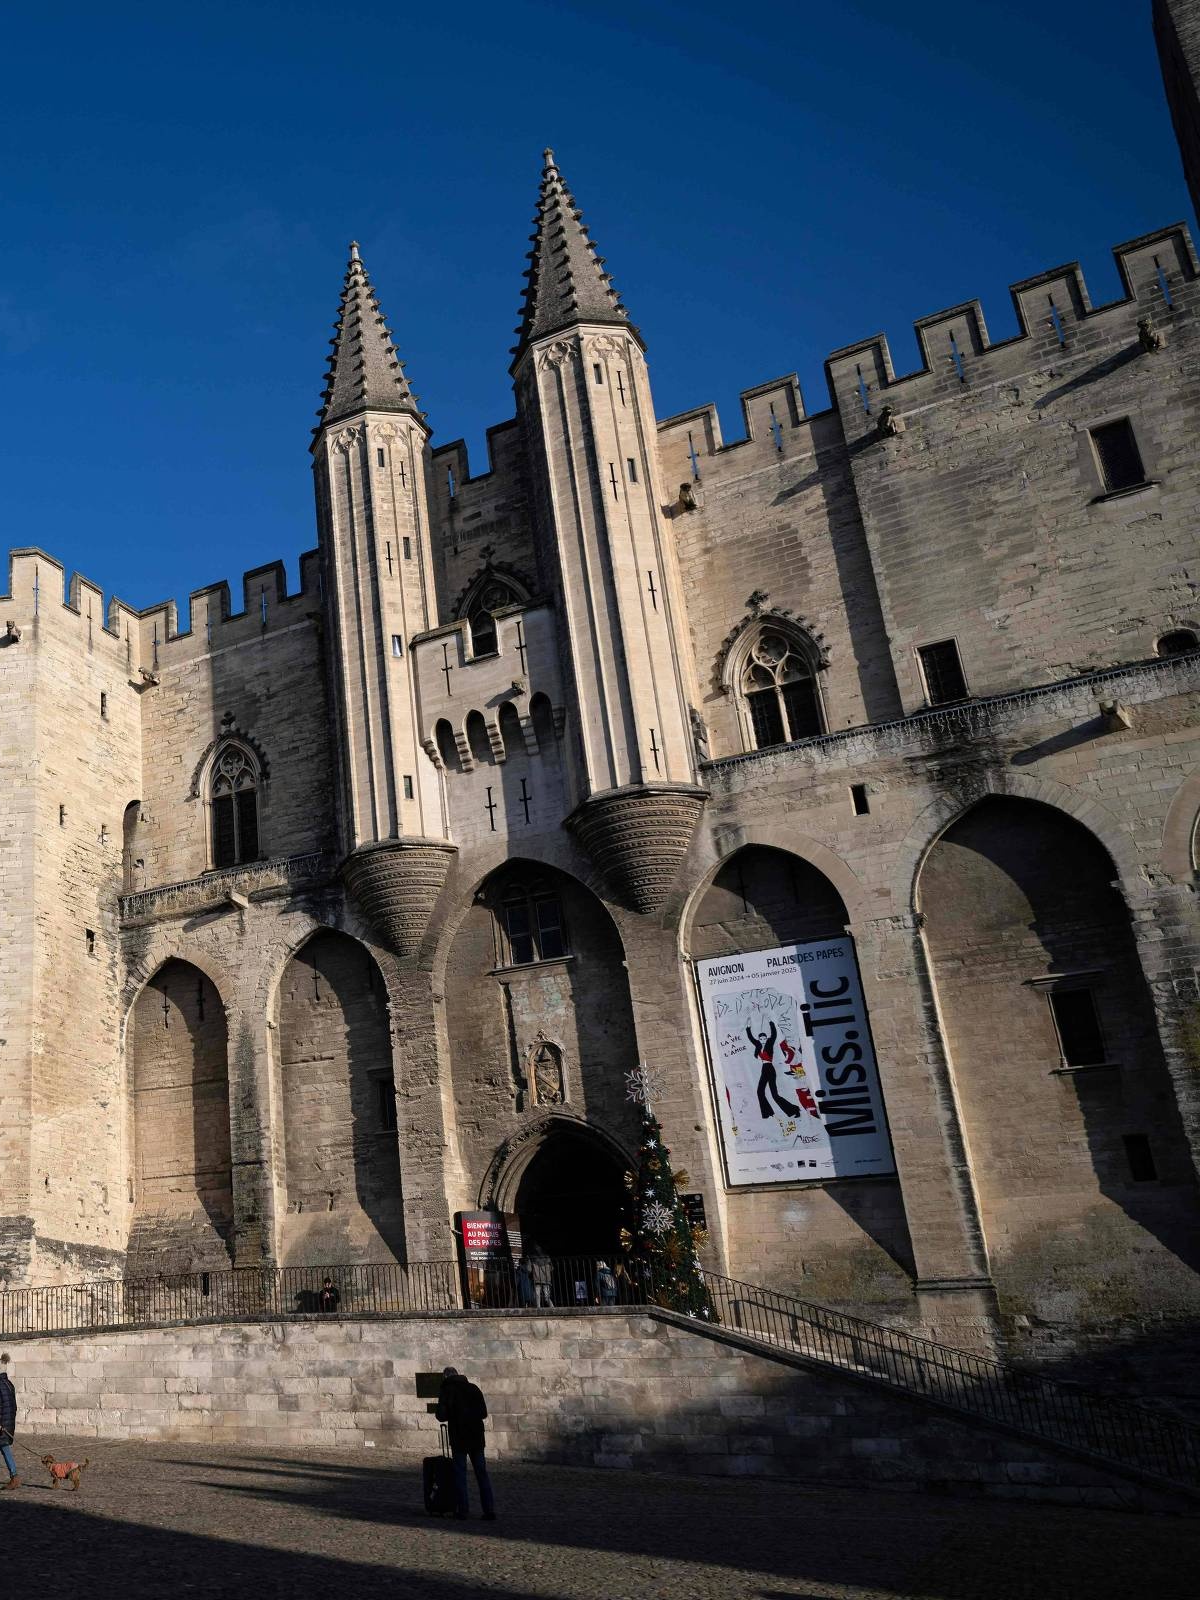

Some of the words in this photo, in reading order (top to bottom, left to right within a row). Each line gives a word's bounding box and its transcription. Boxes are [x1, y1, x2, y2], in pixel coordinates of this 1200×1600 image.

[708, 963, 745, 977] AVIGNON
[766, 955, 795, 967] PALAIS
[797, 950, 815, 963] DES
[816, 947, 844, 960] PAPES
[717, 976, 729, 985] juin
[729, 975, 745, 983] 2024
[760, 969, 781, 979] janvier
[781, 966, 797, 975] 2025
